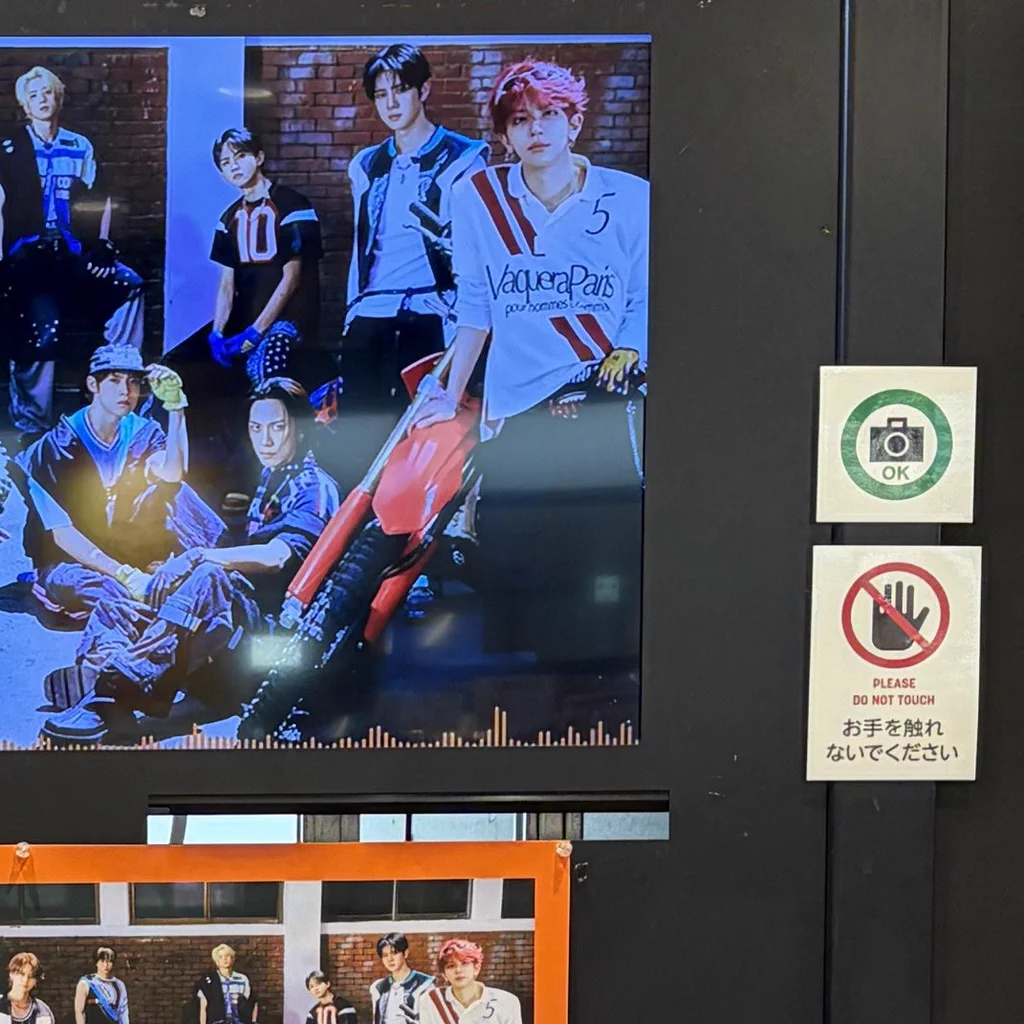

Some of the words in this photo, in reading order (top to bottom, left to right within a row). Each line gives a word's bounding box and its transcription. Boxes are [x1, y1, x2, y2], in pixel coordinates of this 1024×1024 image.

[585, 192, 616, 236] 5
[235, 205, 278, 264] 10
[882, 465, 910, 481] OK
[873, 677, 916, 690] PLEASE
[853, 694, 869, 706] DO
[872, 694, 896, 706] NOT
[898, 694, 935, 706] TOUCH
[843, 718, 944, 738] お手を触れ
[826, 742, 959, 763] ないでください
[482, 999, 497, 1019] 5
